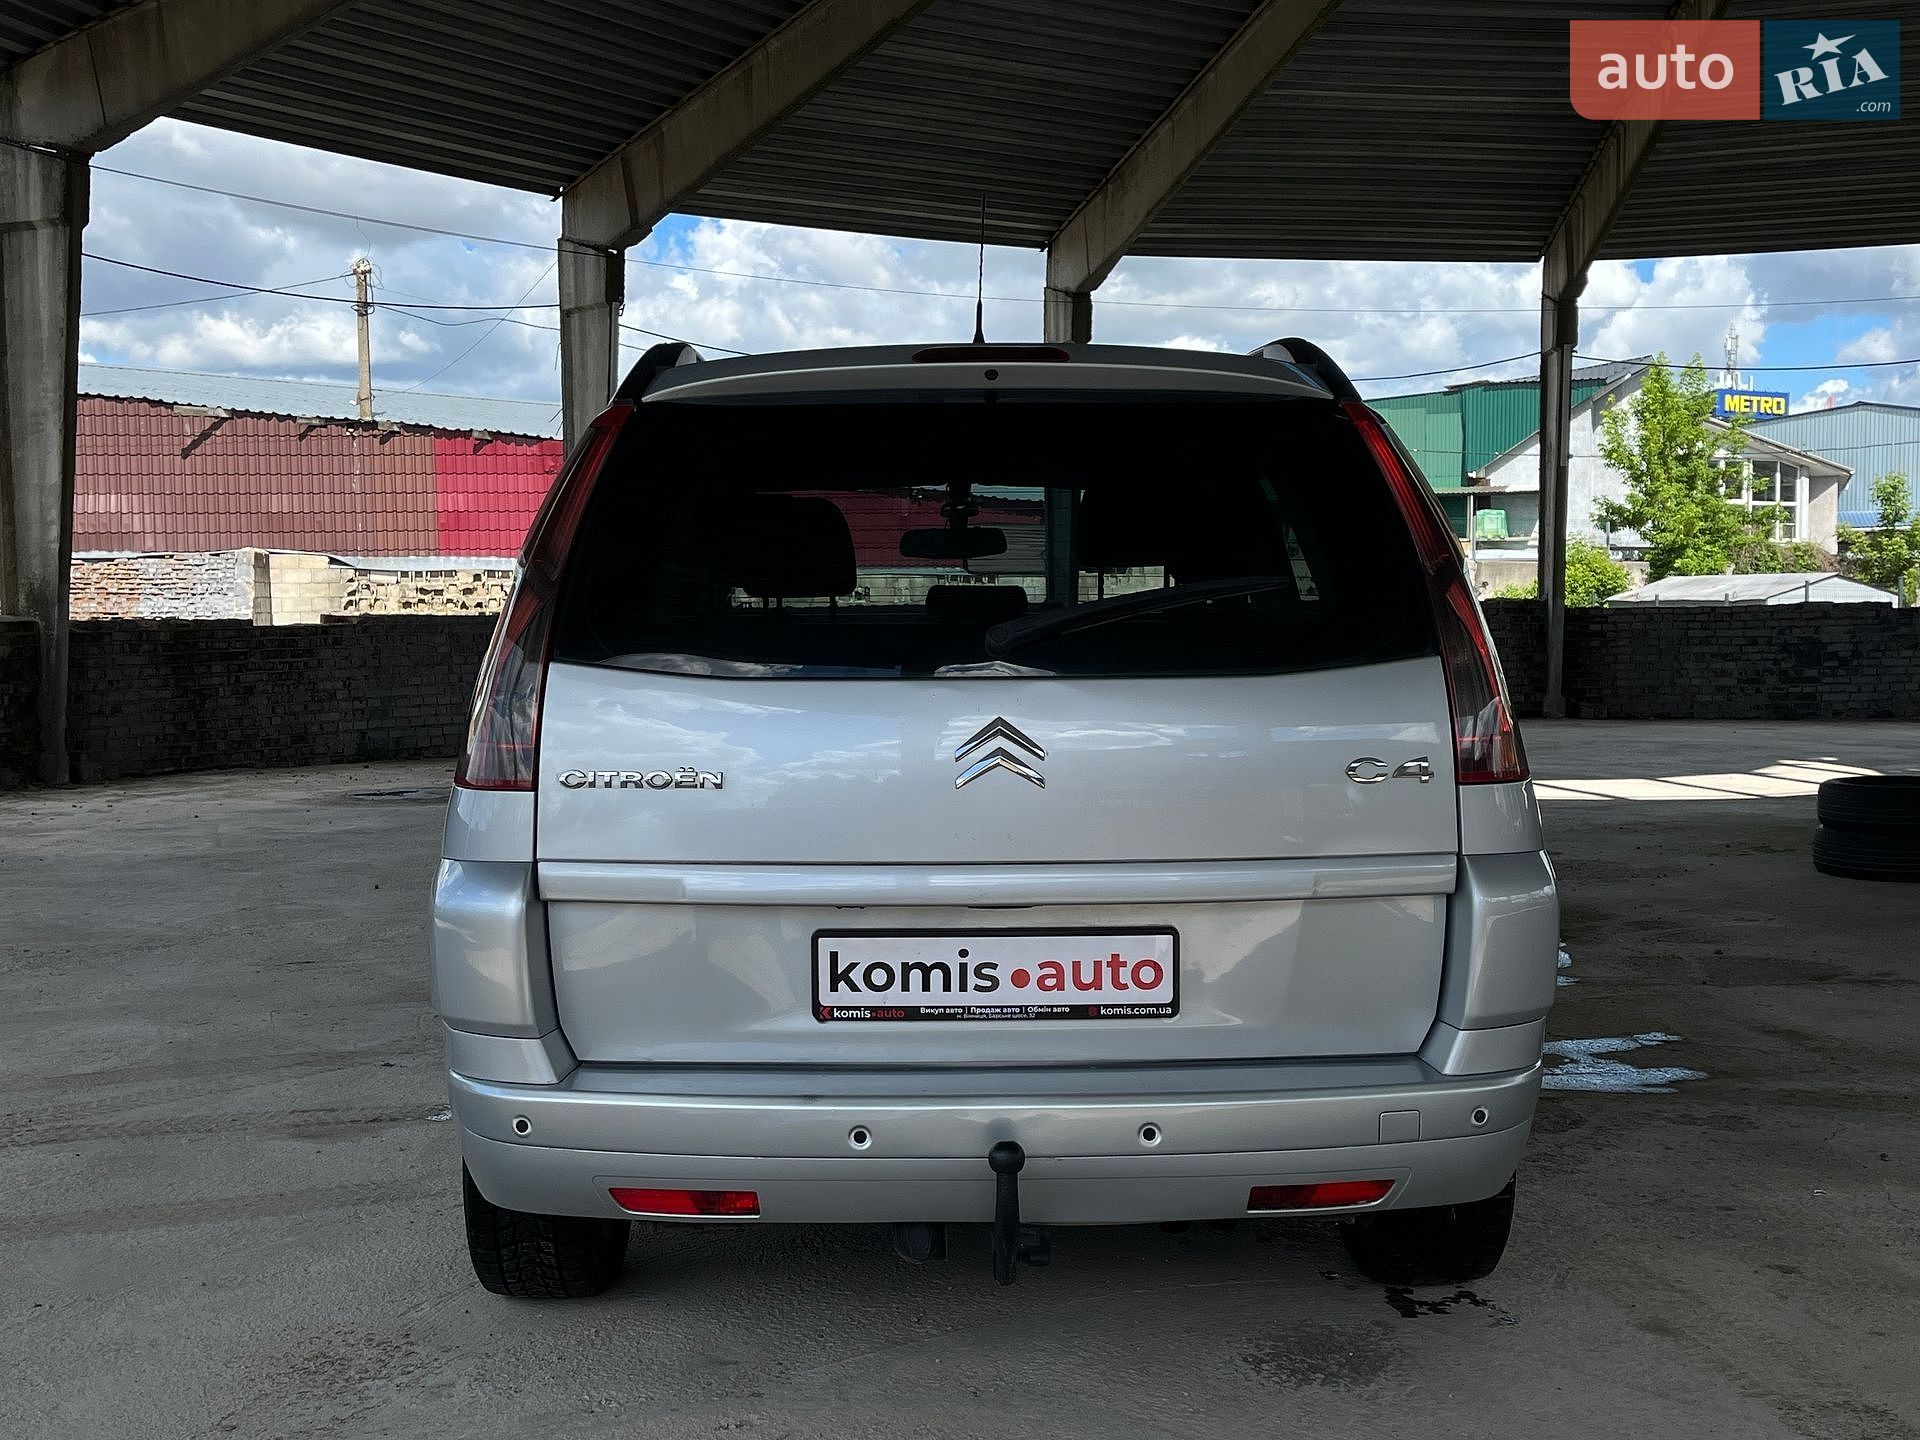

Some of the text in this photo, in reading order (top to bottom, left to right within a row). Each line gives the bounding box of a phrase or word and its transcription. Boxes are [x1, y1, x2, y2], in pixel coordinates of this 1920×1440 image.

[1724, 394, 1786, 415] METRO
[558, 766, 724, 790] CITROËN
[1345, 756, 1435, 784] C4
[828, 948, 1000, 993] komis
[920, 1007, 944, 1015] Викуп
[970, 1007, 1001, 1015] Продаж
[1100, 1006, 1172, 1015] komis.com.ua
